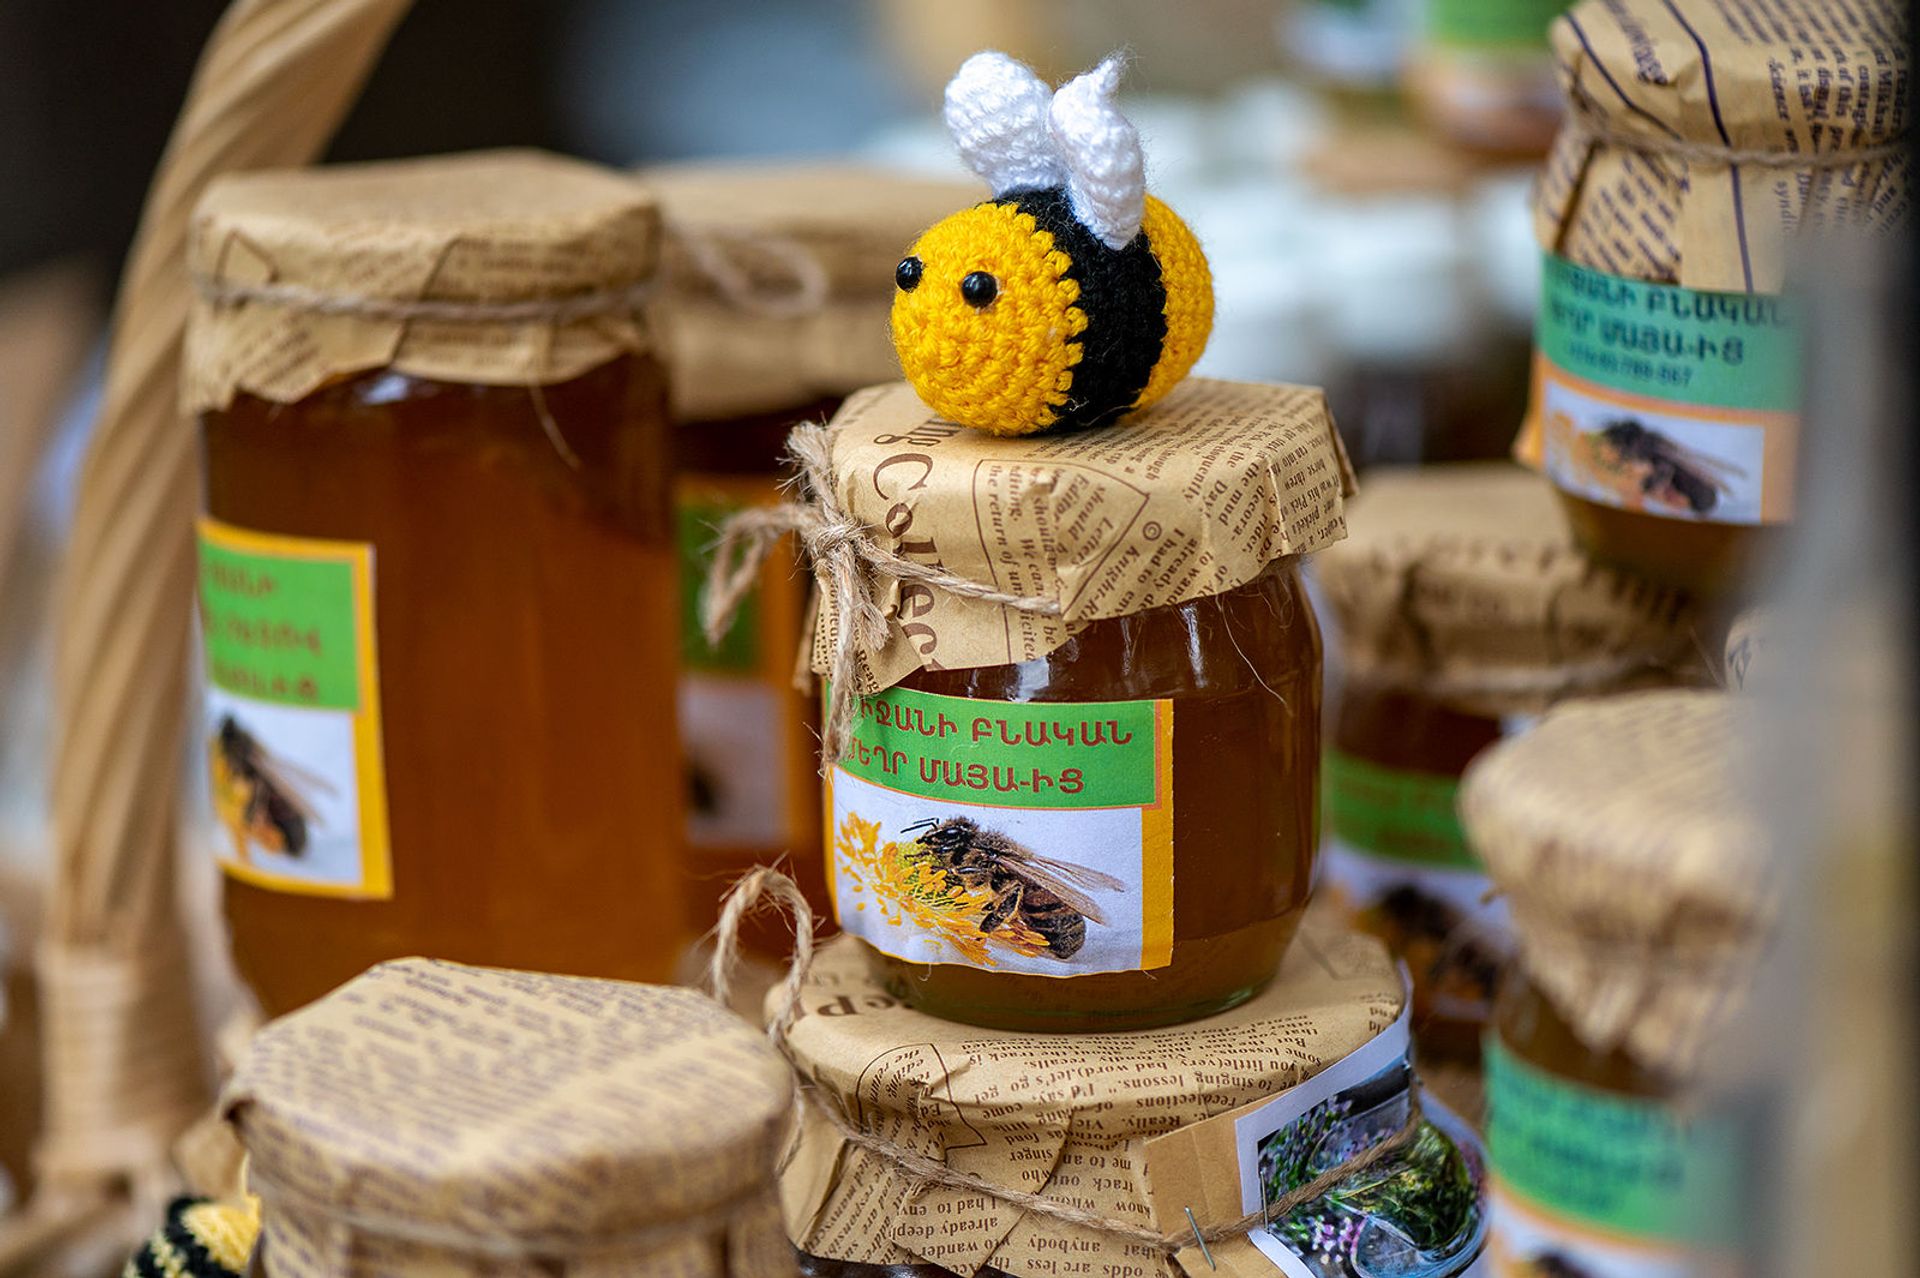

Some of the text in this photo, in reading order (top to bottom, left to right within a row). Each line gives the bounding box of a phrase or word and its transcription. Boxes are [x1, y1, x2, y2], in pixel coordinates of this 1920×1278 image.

[1226, 449, 1245, 469] the
[987, 465, 1002, 486] the
[1240, 462, 1263, 488] the
[1197, 479, 1229, 520] Day!
[1217, 488, 1243, 527] mud
[1287, 493, 1308, 514] Pick
[988, 493, 1008, 547] return
[1067, 484, 1107, 541] should
[1230, 484, 1268, 542] decora-
[1069, 516, 1113, 567] Letters
[1241, 512, 1273, 554] rider,
[999, 551, 1020, 567] of
[1136, 527, 1186, 585] I had to
[1152, 535, 1200, 591] already
[1198, 550, 1215, 566] to
[1213, 564, 1229, 585] of
[1019, 538, 1039, 560] We
[1043, 625, 1058, 645] be
[858, 699, 1133, 746] ԻՋԱՆԻ ԲՆԱԿԱՆ
[919, 756, 1086, 794] ՄԱՅԱ-ԻՑ
[1201, 1028, 1256, 1038] people
[1271, 1022, 1313, 1030] other
[1285, 1028, 1318, 1036] that
[1248, 1031, 1277, 1040] you
[1278, 1038, 1307, 1048] But
[894, 1046, 920, 1064] the
[988, 1052, 1034, 1062] track
[1099, 1055, 1153, 1063] fondly
[1139, 1046, 1192, 1055] things
[1285, 1047, 1322, 1067] some
[969, 1054, 983, 1066] is
[1024, 1058, 1086, 1070] recalls.
[1134, 1057, 1168, 1073] bad
[1269, 1059, 1297, 1075] you
[1010, 1075, 1030, 1092] go
[1194, 1070, 1255, 1090] singing
[1256, 1078, 1273, 1092] to
[973, 1084, 1000, 1106] get
[1031, 1090, 1064, 1109] say,
[1070, 1082, 1095, 1099] I'd
[979, 1102, 1024, 1119] come
[1095, 1100, 1114, 1114] of
[1075, 1118, 1104, 1131] Vic
[1121, 1114, 1182, 1129] Really.
[1002, 1130, 1040, 1146] fond
[1009, 1147, 1132, 1171] me to an singer
[1046, 1171, 1081, 1189] out
[1092, 1177, 1134, 1194] track
[936, 1202, 952, 1215] to
[957, 1197, 985, 1215] had
[989, 1195, 996, 1210] I
[1113, 1200, 1151, 1219] know
[861, 1207, 878, 1235] are
[940, 1217, 998, 1237] already
[919, 1241, 979, 1261] wander
[1027, 1233, 1101, 1254] anybody
[1123, 1241, 1157, 1261] that
[1026, 1258, 1057, 1275] less
[1063, 1261, 1091, 1273] are
[1102, 1264, 1143, 1278] odds
